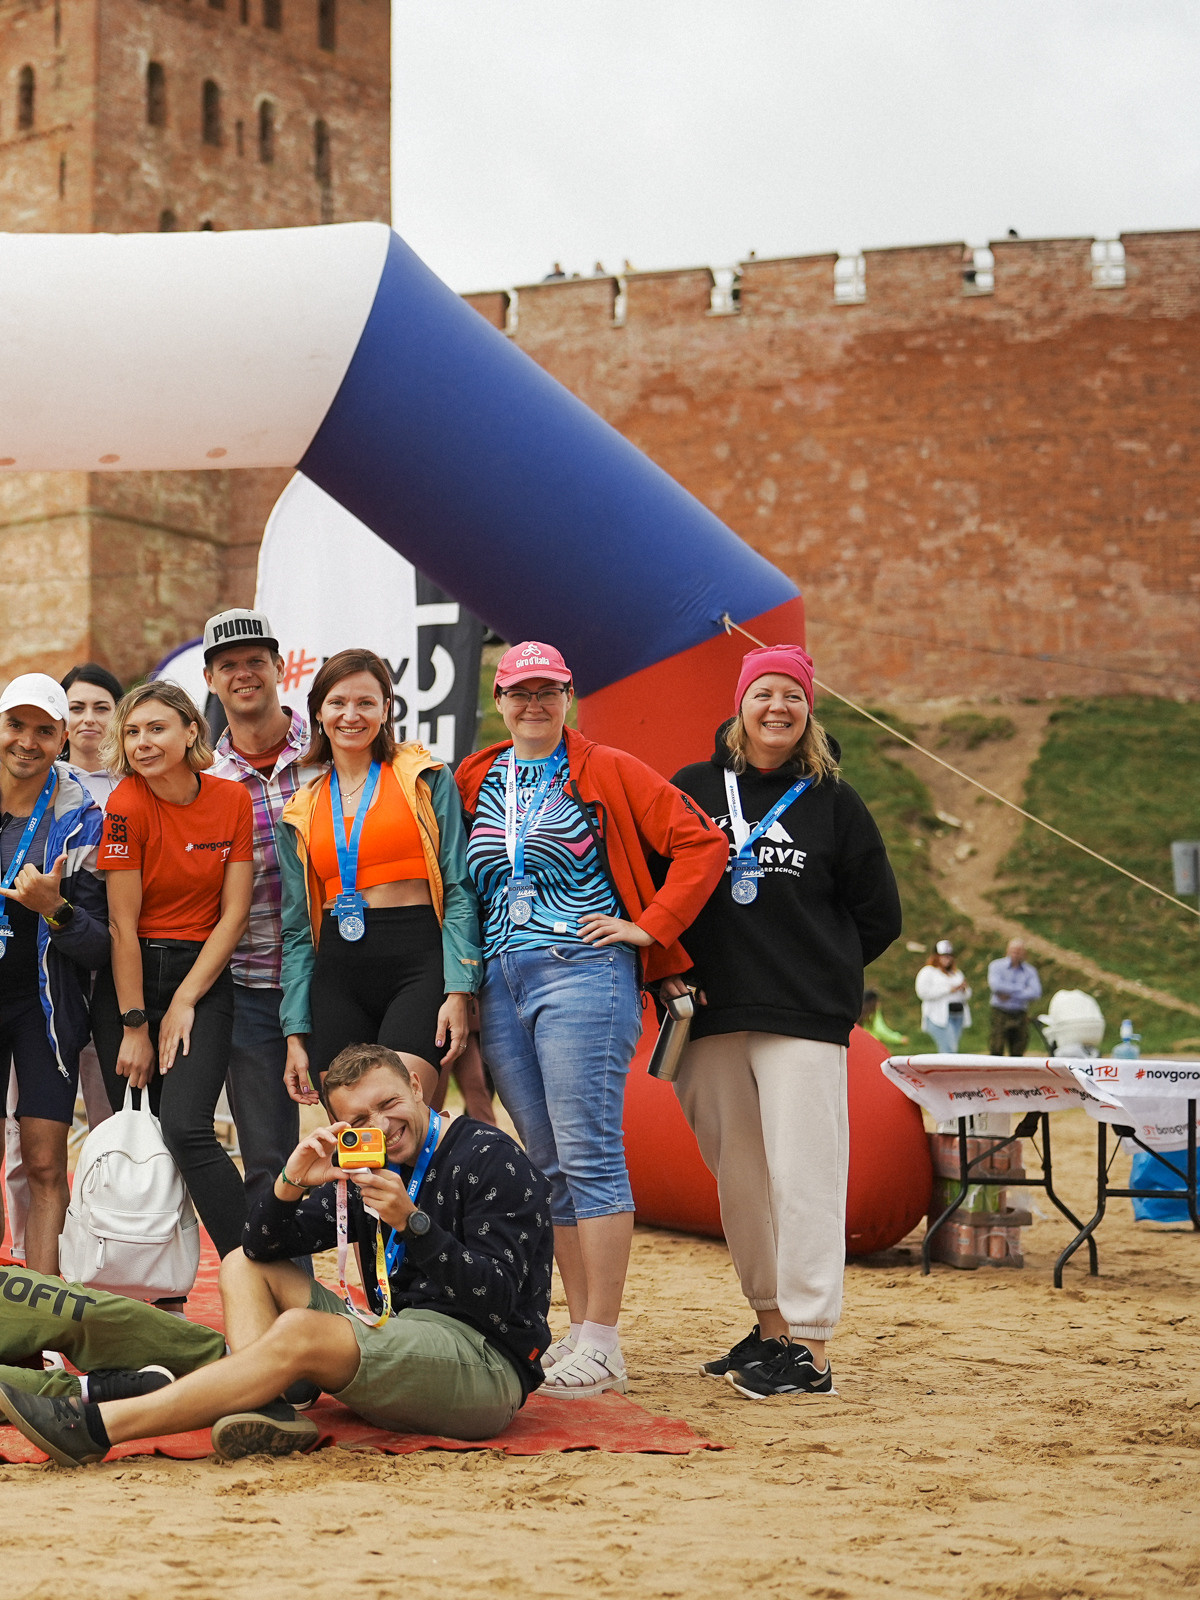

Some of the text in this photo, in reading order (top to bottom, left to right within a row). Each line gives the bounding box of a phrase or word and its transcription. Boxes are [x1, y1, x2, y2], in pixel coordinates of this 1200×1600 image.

[213, 618, 263, 642] PUMA
[516, 658, 529, 668] Giro
[794, 780, 806, 793] 2023
[27, 817, 38, 832] 2023
[111, 823, 127, 834] go
[107, 832, 128, 843] rod
[104, 844, 128, 855] TRI
[185, 840, 232, 852] #novgoro
[774, 867, 801, 878] SCHOOL
[1095, 1066, 1118, 1078] TRI
[1135, 1068, 1200, 1083] #novgoro
[408, 1180, 418, 1197] 2023
